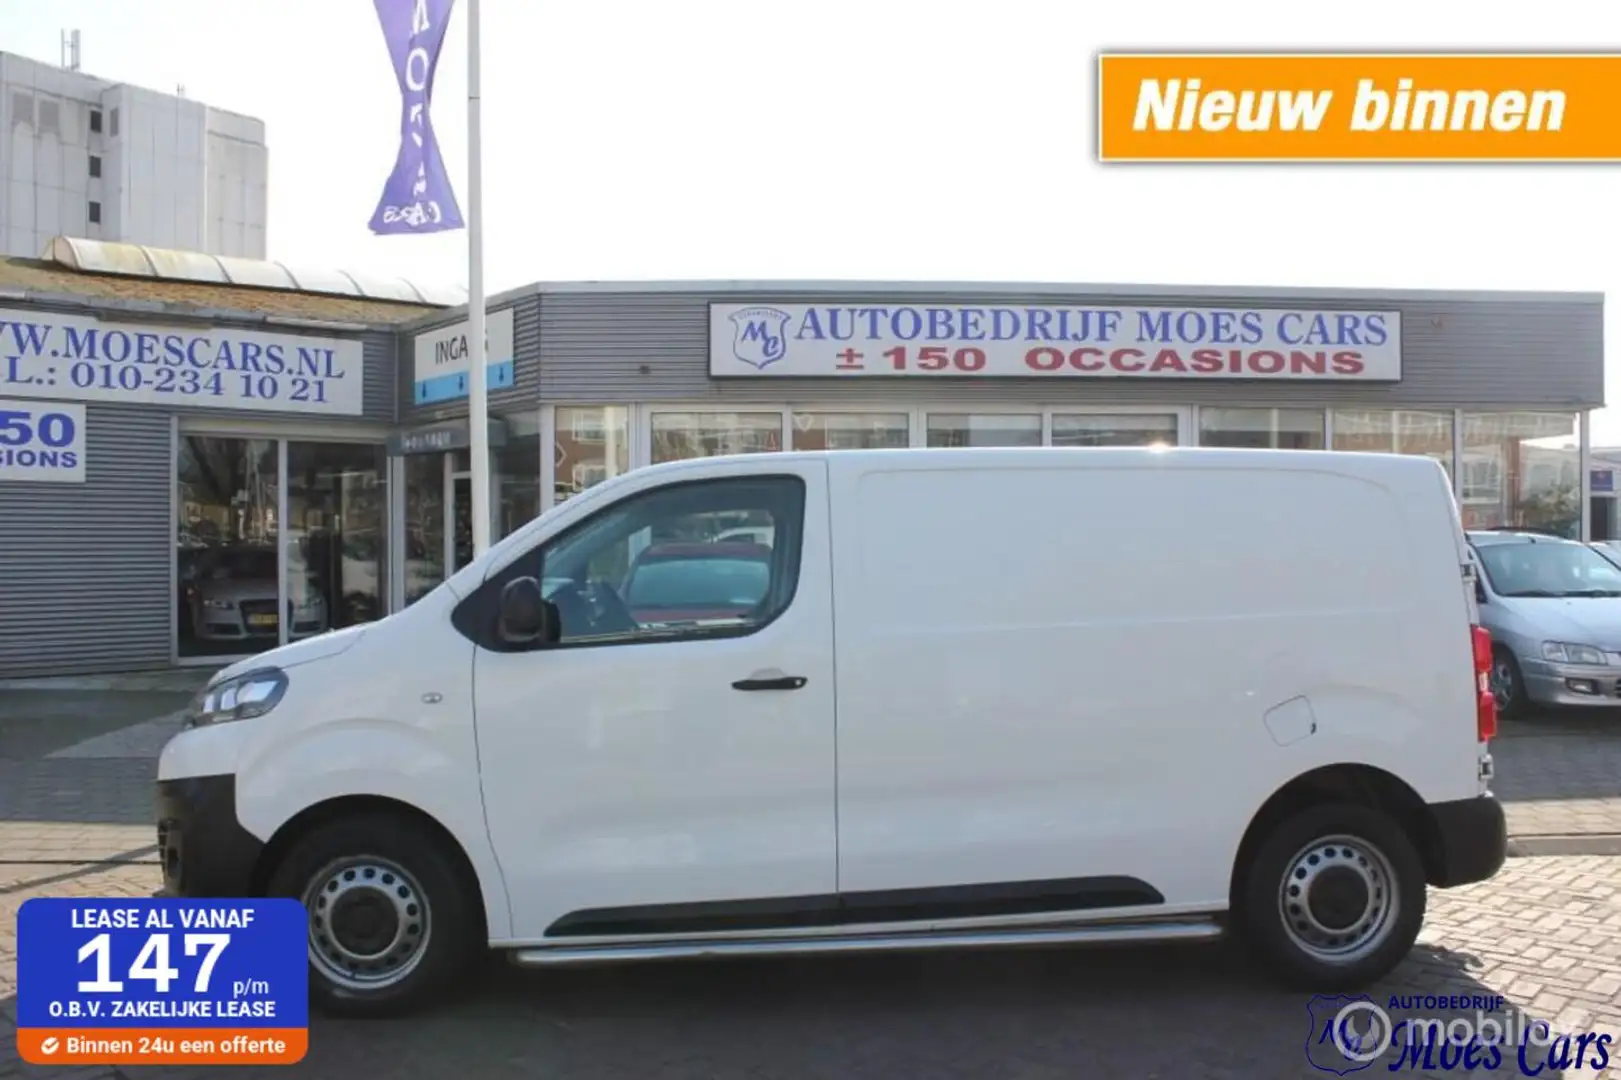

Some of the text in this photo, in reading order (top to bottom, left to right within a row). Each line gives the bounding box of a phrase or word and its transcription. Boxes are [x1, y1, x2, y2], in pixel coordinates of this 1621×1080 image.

[794, 307, 1388, 347] AUTOBEDRIJF MOES CARS
[0, 321, 346, 379] W.MOESCARS.NL
[883, 346, 986, 372] 150
[1025, 347, 1365, 375] OCCASIONS
[70, 362, 225, 396] 010-234
[240, 374, 279, 400] 10
[289, 378, 328, 403] 21
[0, 410, 76, 448] 50
[0, 449, 78, 469] IONS
